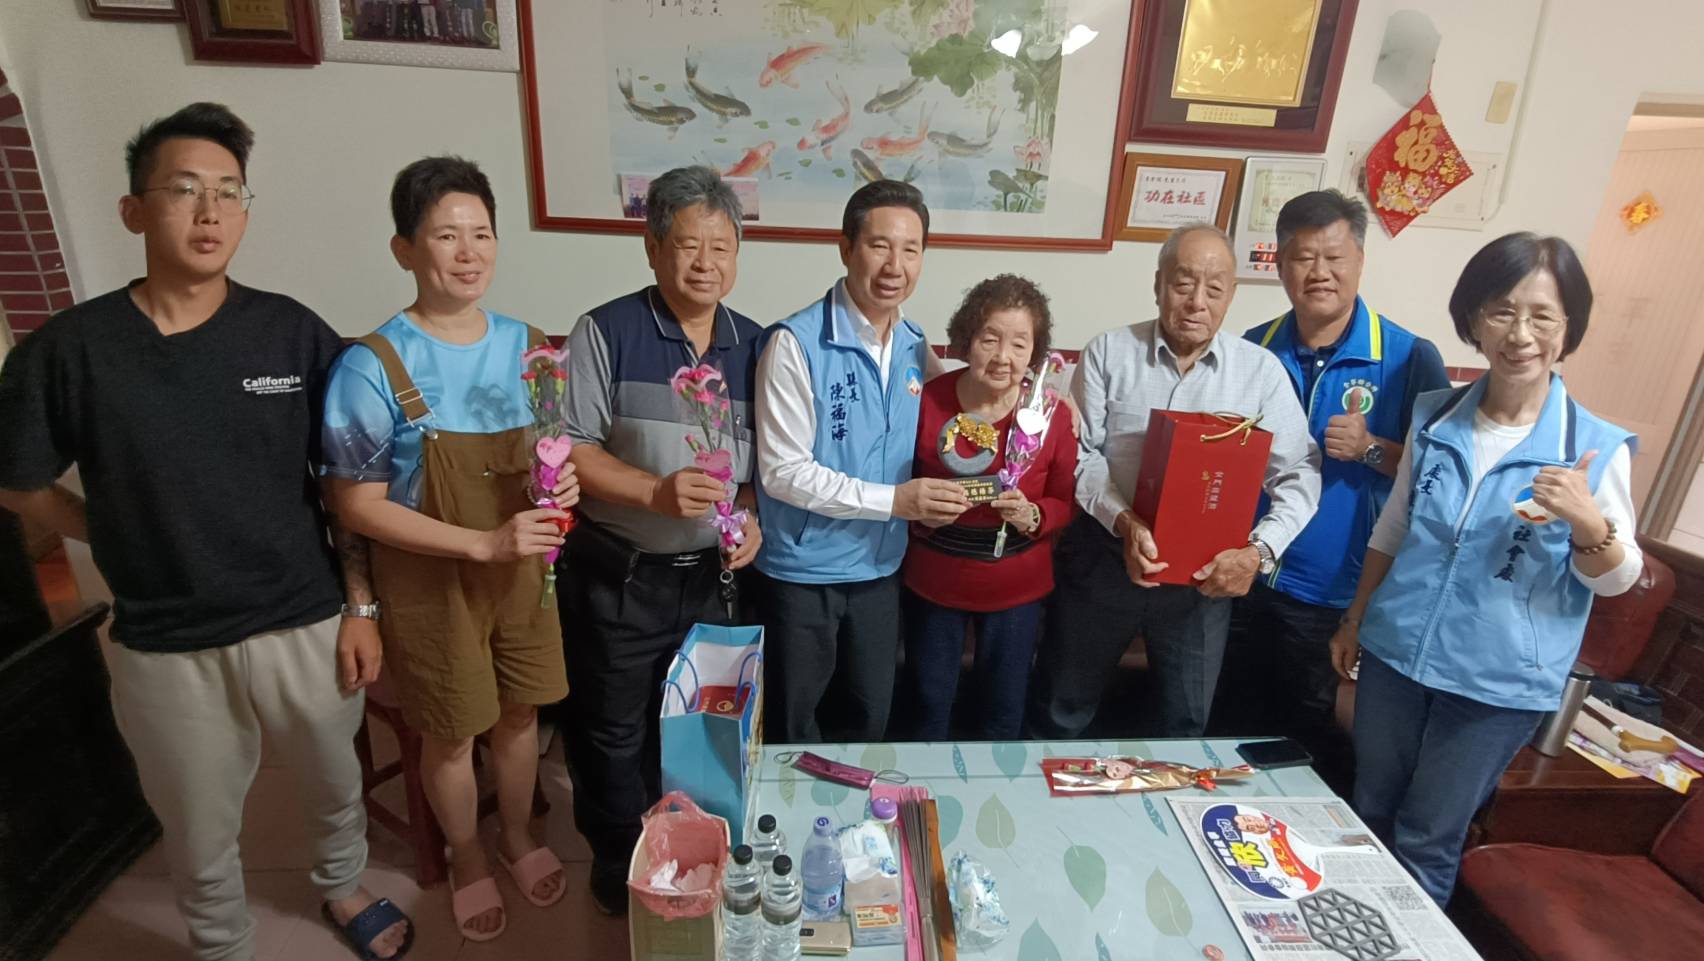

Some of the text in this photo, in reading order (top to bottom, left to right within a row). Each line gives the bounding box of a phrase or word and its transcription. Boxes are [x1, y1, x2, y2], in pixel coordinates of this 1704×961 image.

[1394, 109, 1442, 172] 福
[1144, 190, 1207, 205] 功在社區
[1631, 202, 1650, 224] 春
[242, 374, 302, 387] California
[846, 371, 860, 403] 縣長
[830, 382, 849, 441] 陳福海
[1494, 525, 1532, 583] 社會處
